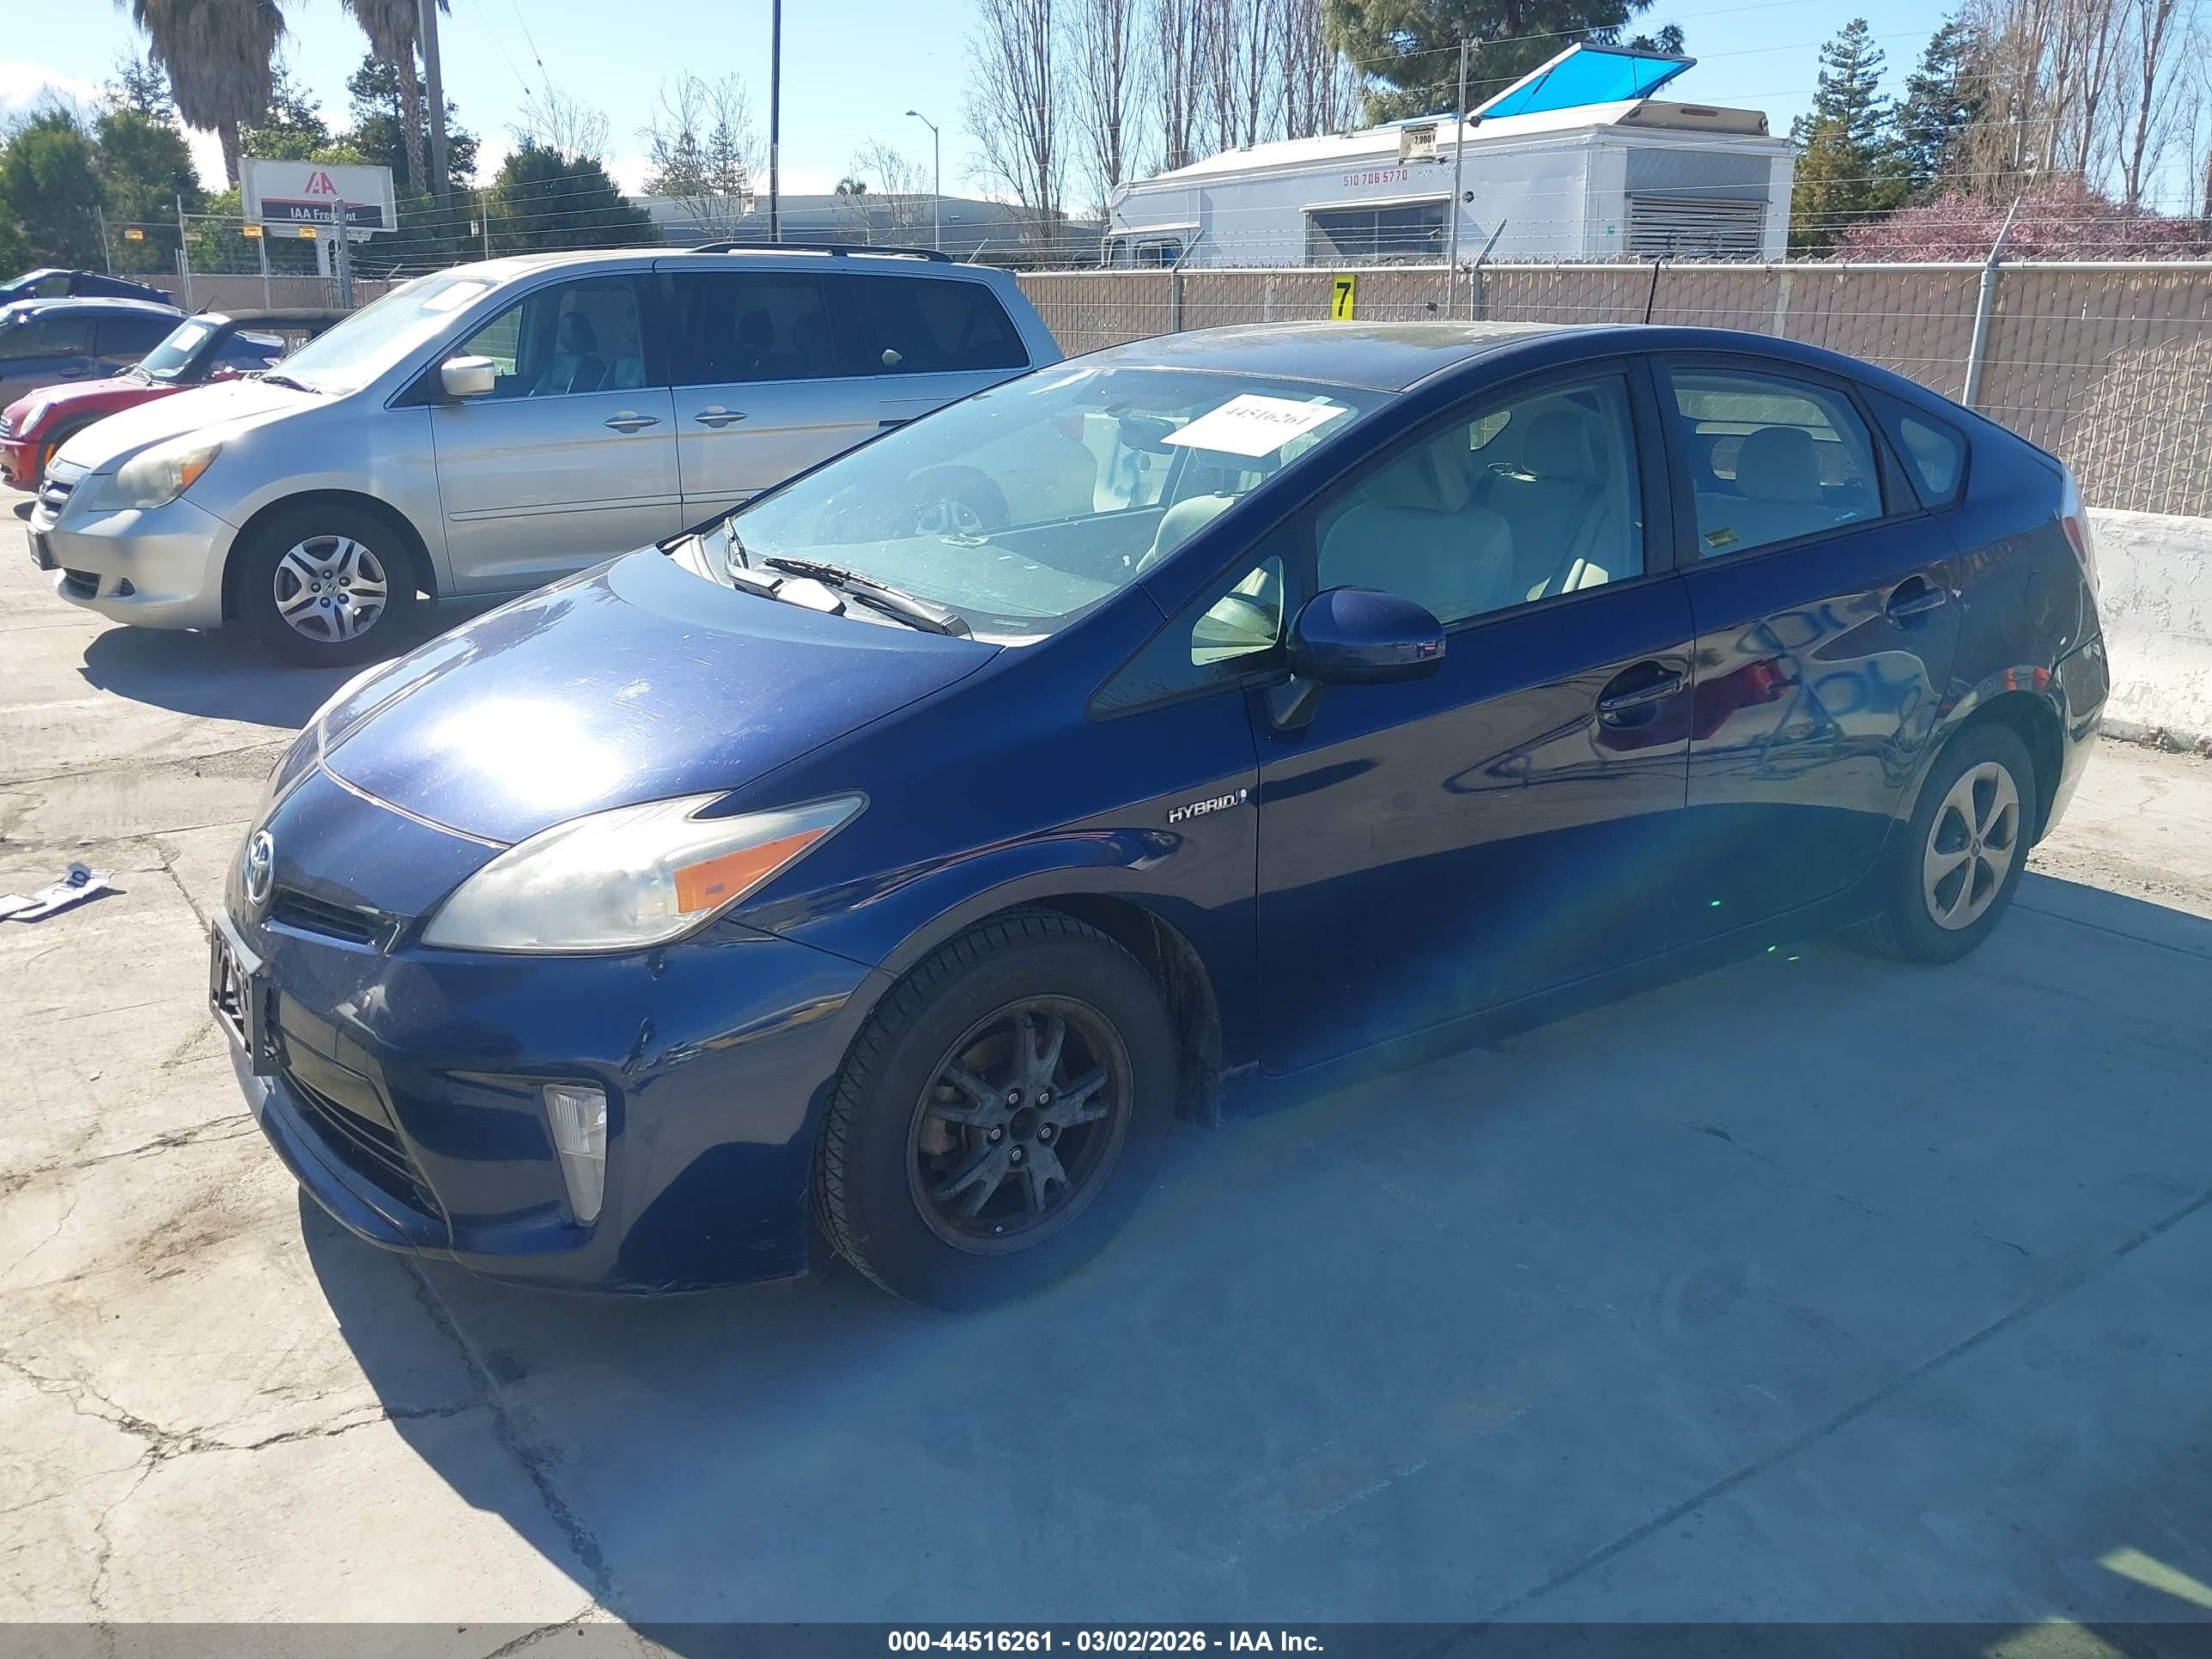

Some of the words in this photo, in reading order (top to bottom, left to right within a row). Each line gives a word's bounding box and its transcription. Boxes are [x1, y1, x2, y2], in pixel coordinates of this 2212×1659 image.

[1343, 174, 1359, 186] 510
[1383, 169, 1407, 183] 5770
[290, 207, 311, 219] IAA
[313, 209, 357, 222] Frent
[1336, 282, 1352, 317] 7
[1224, 406, 1311, 426] 44516261
[1169, 794, 1237, 823] HYBRID
